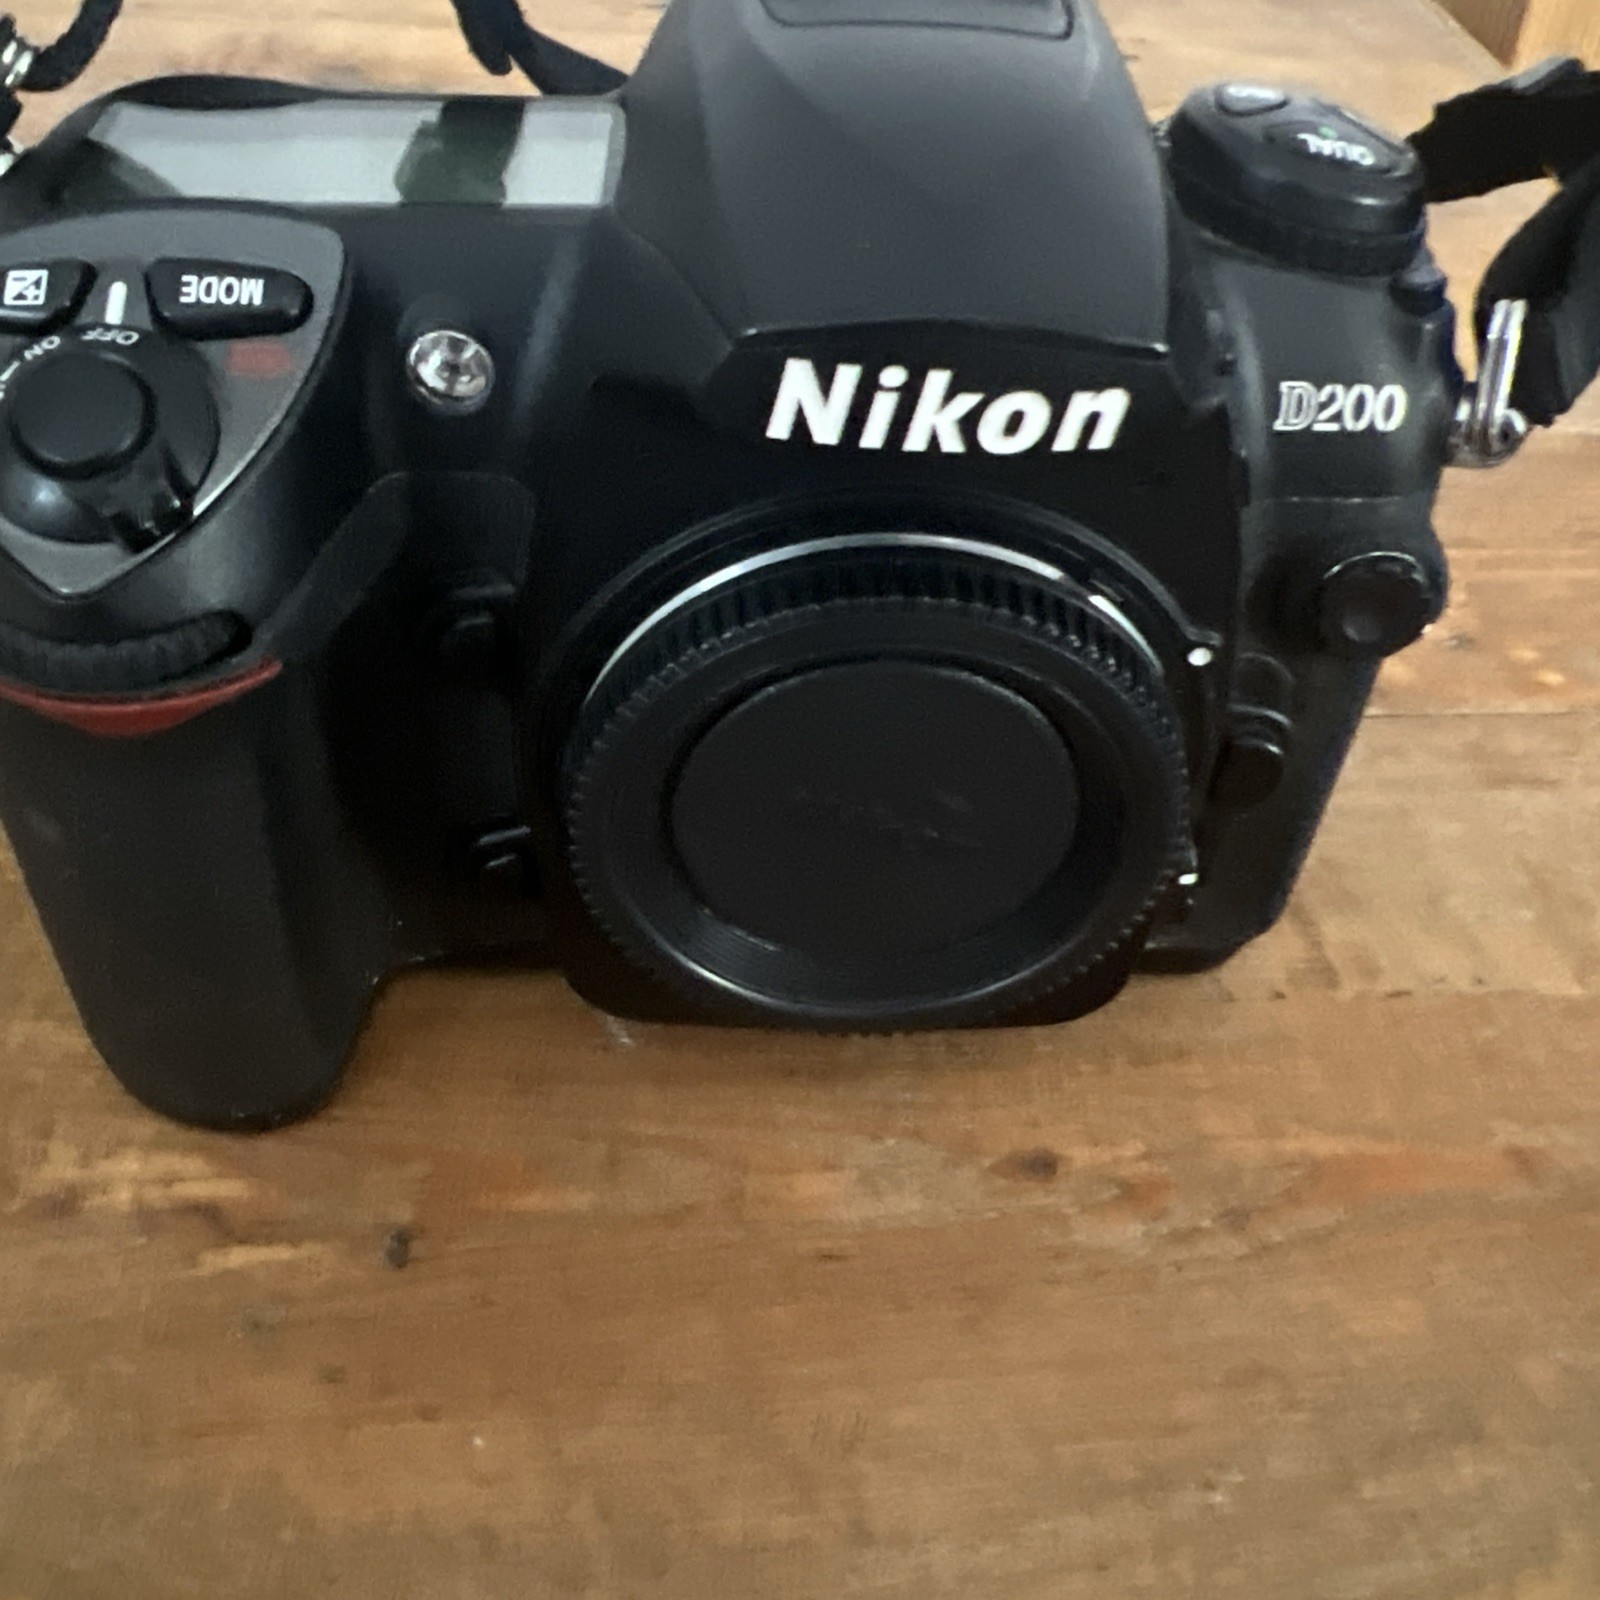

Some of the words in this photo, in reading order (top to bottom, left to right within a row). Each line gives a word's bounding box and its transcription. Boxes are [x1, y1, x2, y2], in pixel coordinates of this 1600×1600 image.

[179, 274, 265, 306] MODE
[23, 335, 61, 361] ON
[81, 327, 140, 346] OFF
[765, 358, 1130, 455] Nikon
[1272, 380, 1409, 433] D200
